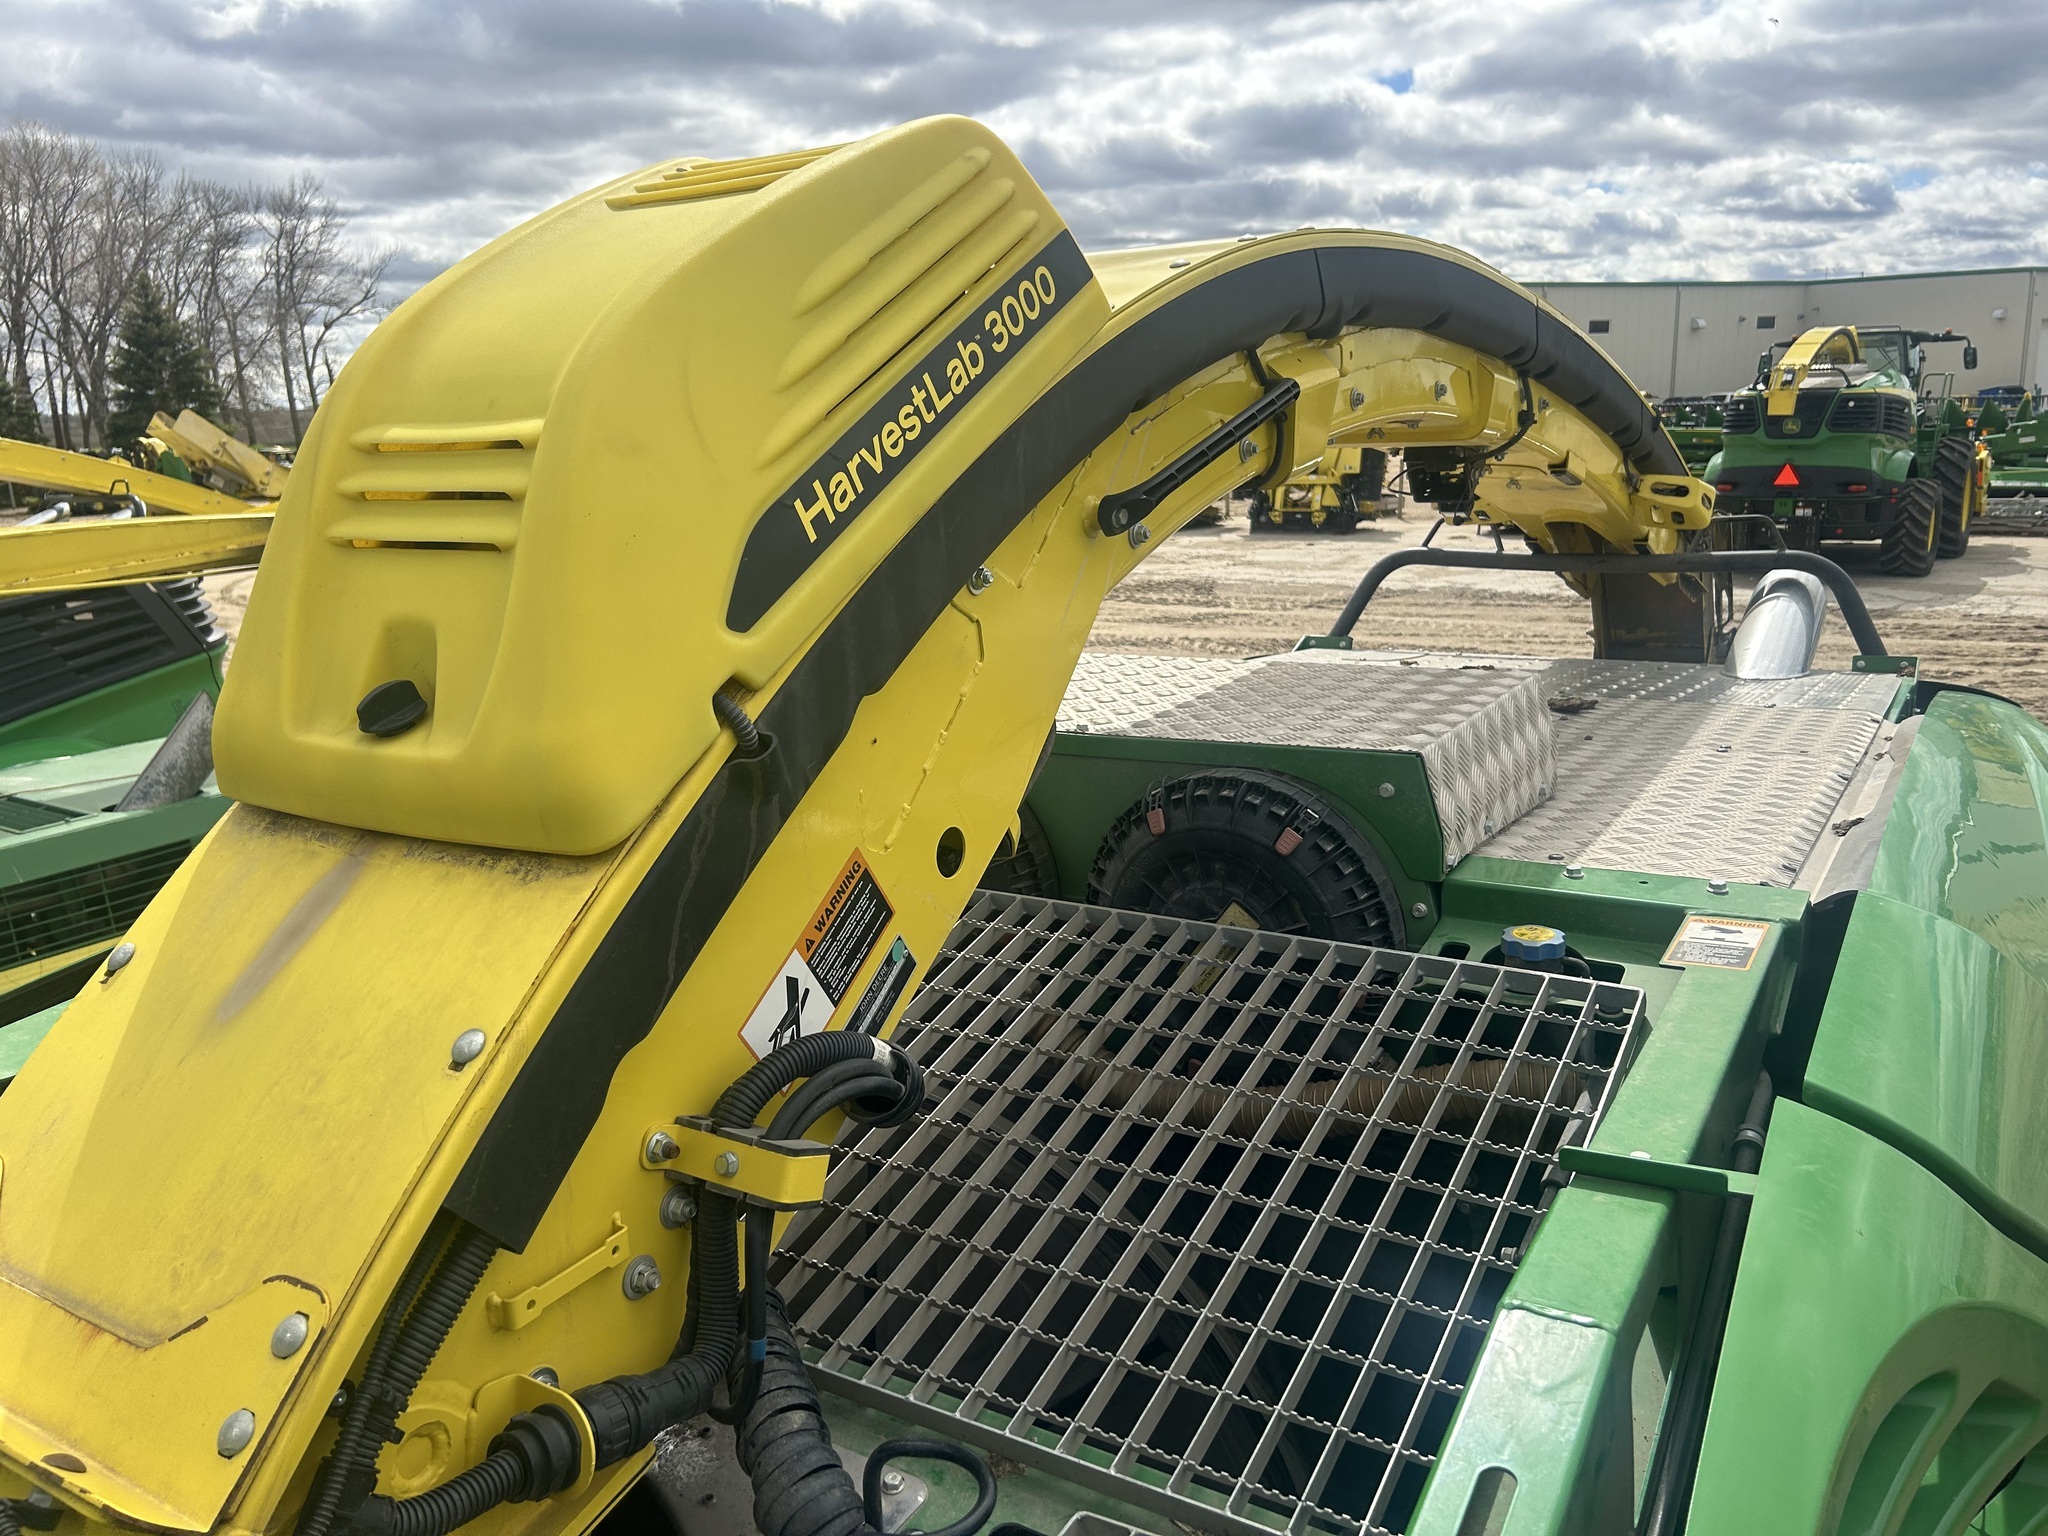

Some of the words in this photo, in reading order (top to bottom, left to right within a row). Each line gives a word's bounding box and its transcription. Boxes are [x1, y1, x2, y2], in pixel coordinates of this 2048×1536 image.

[984, 265, 1056, 353] 3000
[814, 861, 862, 933] WARNING
[1707, 919, 1764, 929] WARNING
[860, 992, 873, 1012] JOHN
[872, 964, 887, 991] DEERE
